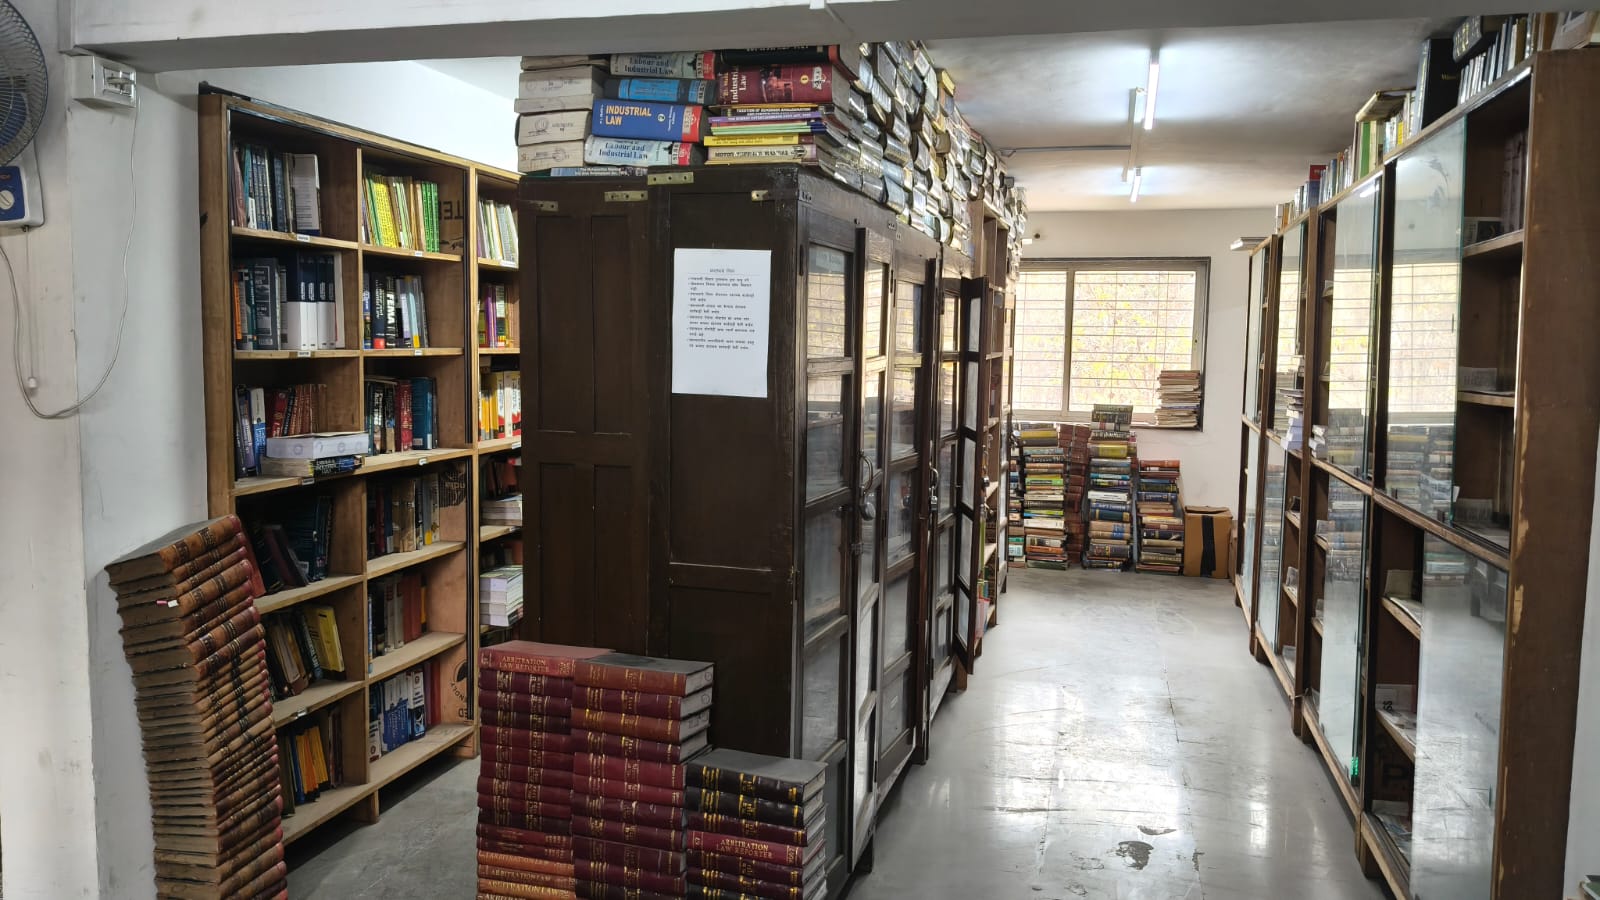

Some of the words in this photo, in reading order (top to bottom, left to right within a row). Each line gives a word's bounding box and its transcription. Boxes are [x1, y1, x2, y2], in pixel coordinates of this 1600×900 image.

[625, 65, 658, 74] Industrial
[660, 67, 674, 75] Law
[739, 75, 747, 91] Law
[605, 105, 652, 117] INDUSTRIAL
[605, 115, 622, 126] LAW
[599, 149, 634, 158] Industrial
[635, 151, 648, 159] Law
[387, 294, 395, 324] FEMA
[502, 656, 546, 666] ARBITRATION
[515, 663, 550, 672] REPORTER
[720, 839, 769, 851] ARBITRATION
[716, 844, 732, 853] LAW
[734, 846, 773, 859] REPORTER
[491, 869, 537, 880] ARBITRATION
[488, 880, 541, 893] ARBITRATION
